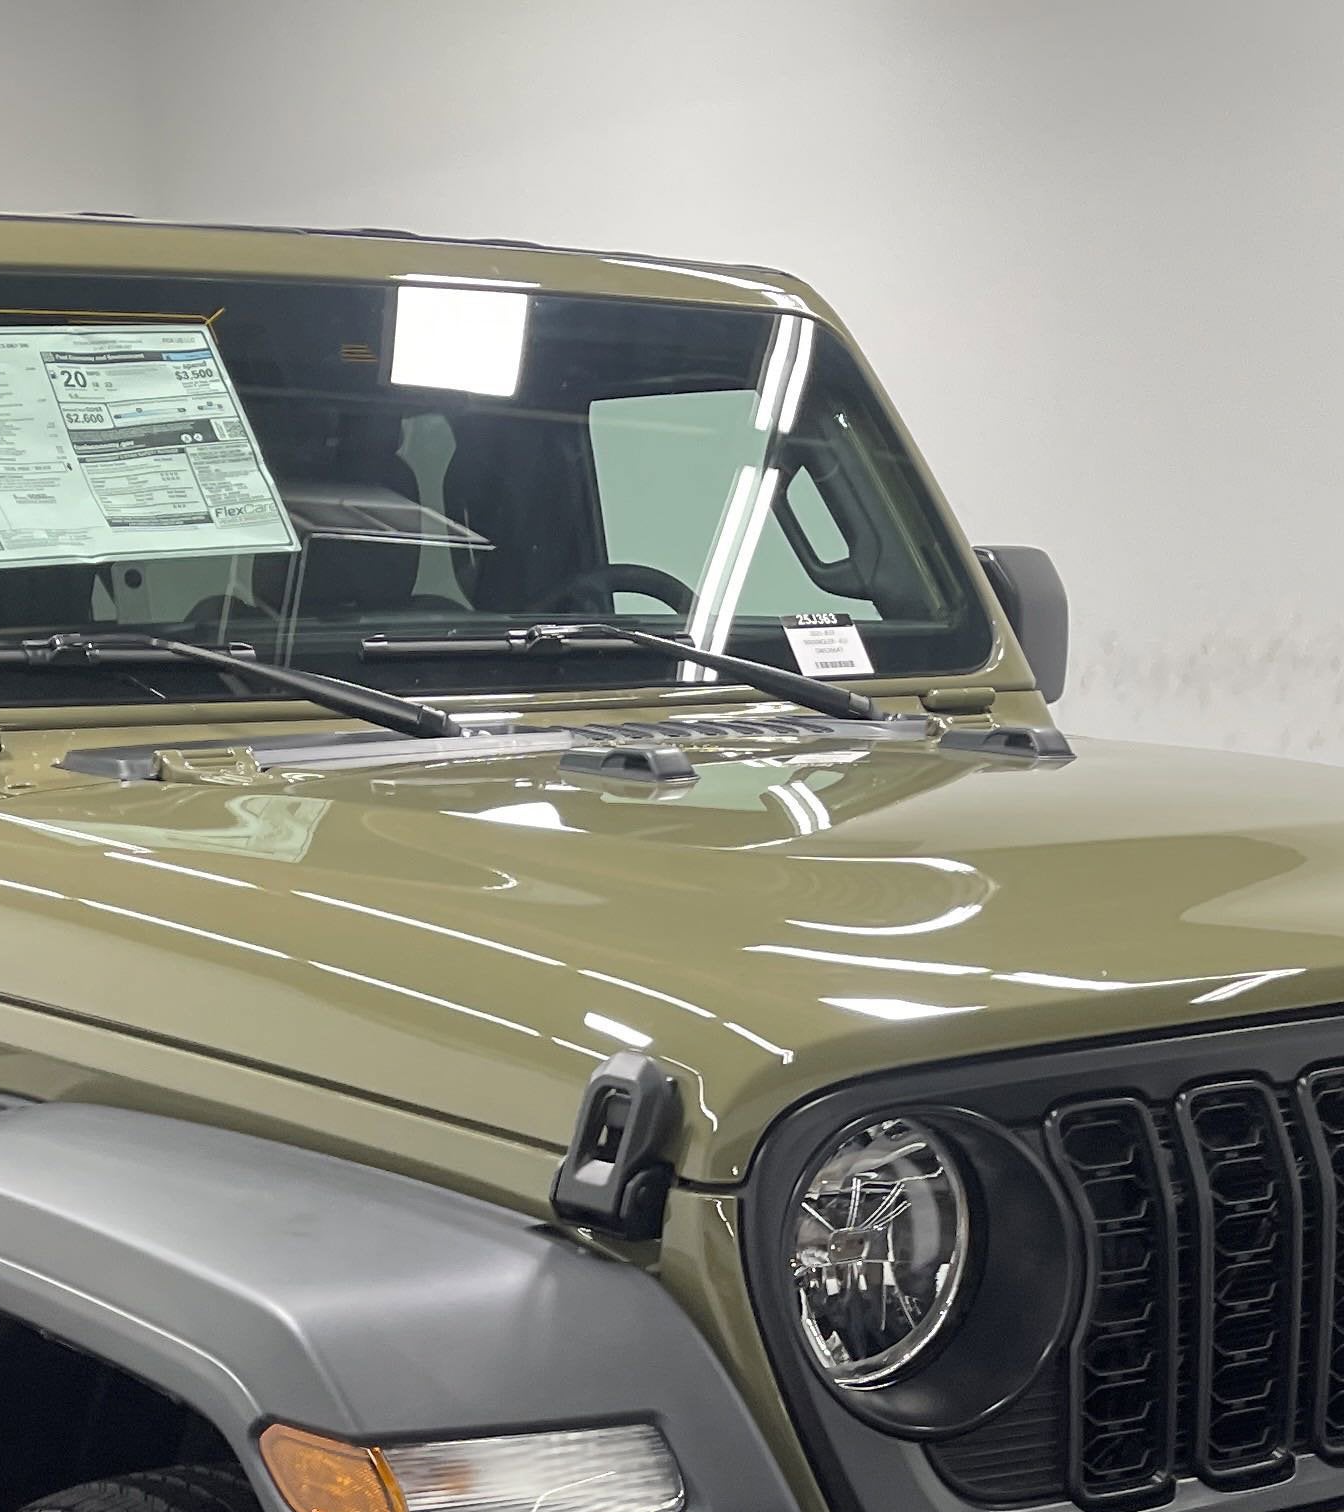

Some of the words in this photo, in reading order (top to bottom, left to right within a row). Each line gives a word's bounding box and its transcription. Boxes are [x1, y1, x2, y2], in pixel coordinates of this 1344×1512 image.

[60, 370, 88, 388] 20
[175, 368, 214, 382] $3,500
[66, 413, 105, 425] $2,600
